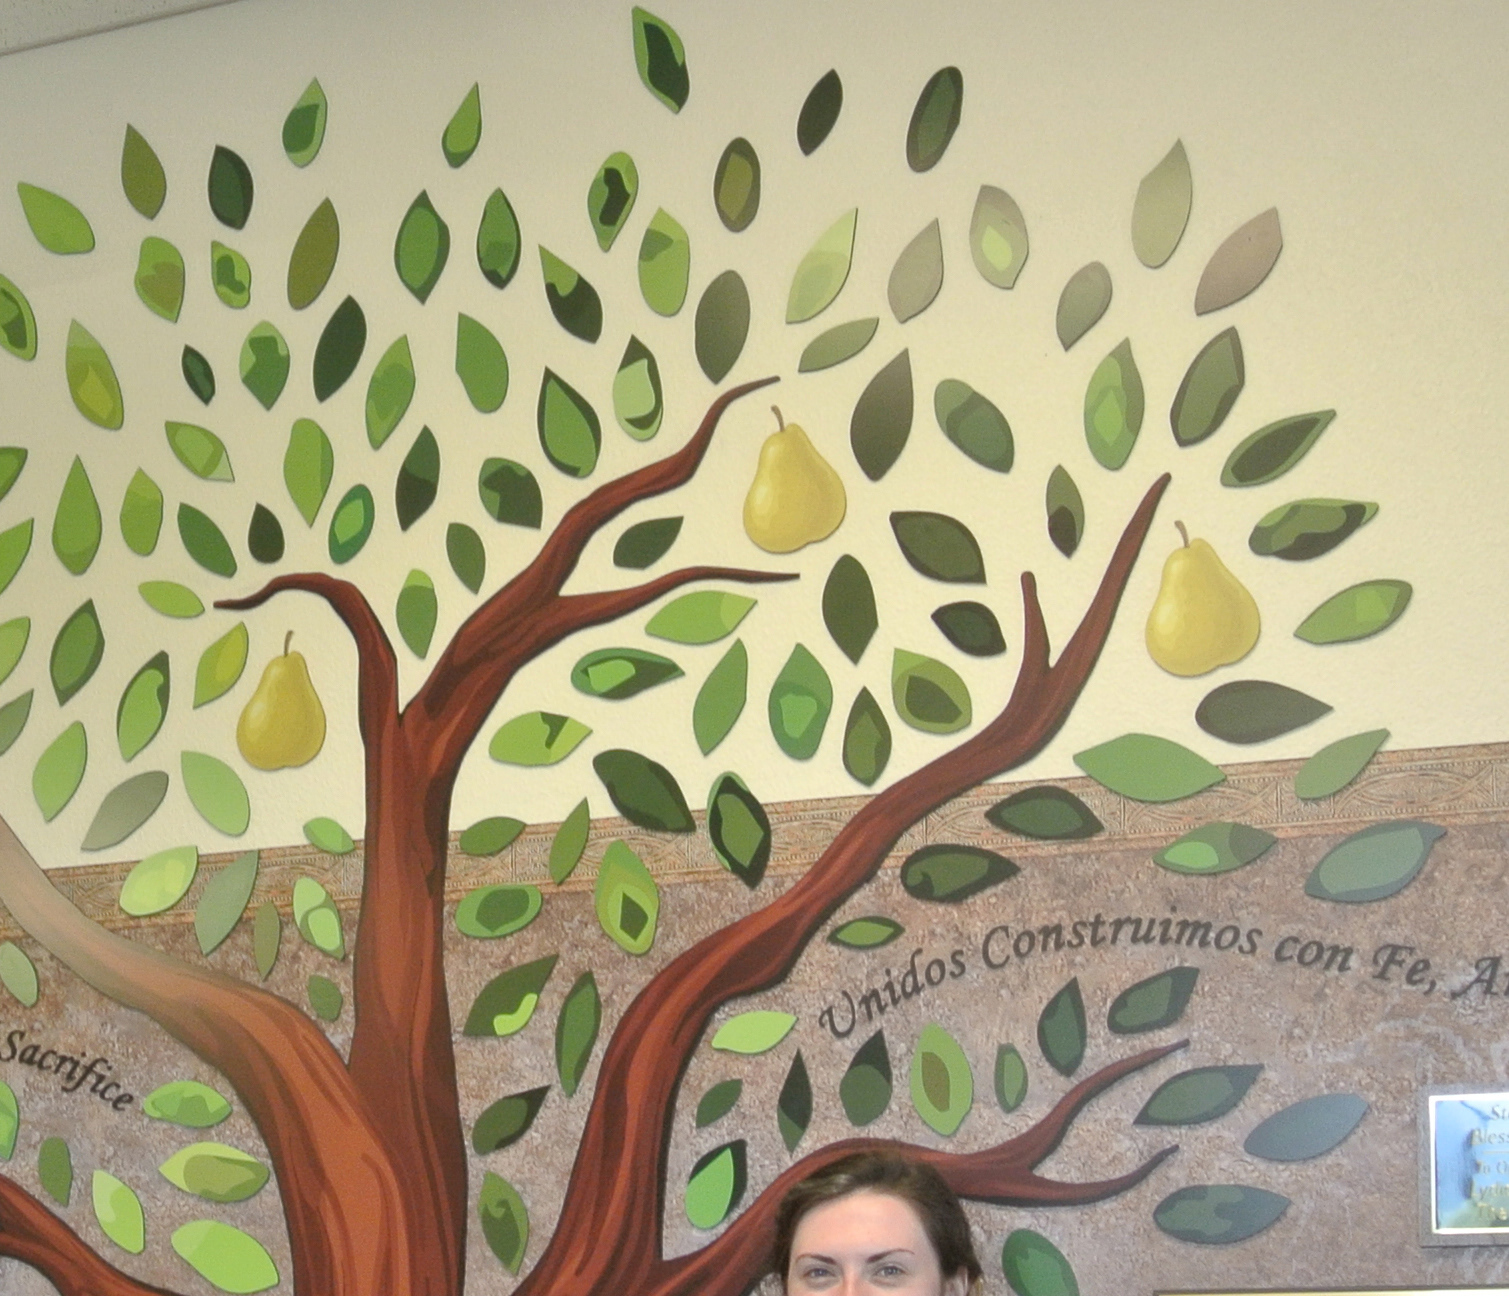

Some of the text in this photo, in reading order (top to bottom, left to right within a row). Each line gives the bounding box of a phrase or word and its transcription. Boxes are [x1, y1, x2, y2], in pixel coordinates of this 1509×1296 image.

[818, 947, 966, 1039] Unidos
[981, 906, 1263, 970] Construimos
[1274, 935, 1354, 973] con
[1371, 942, 1437, 995] Fe,
[0, 1029, 134, 1112] Sacrifice
